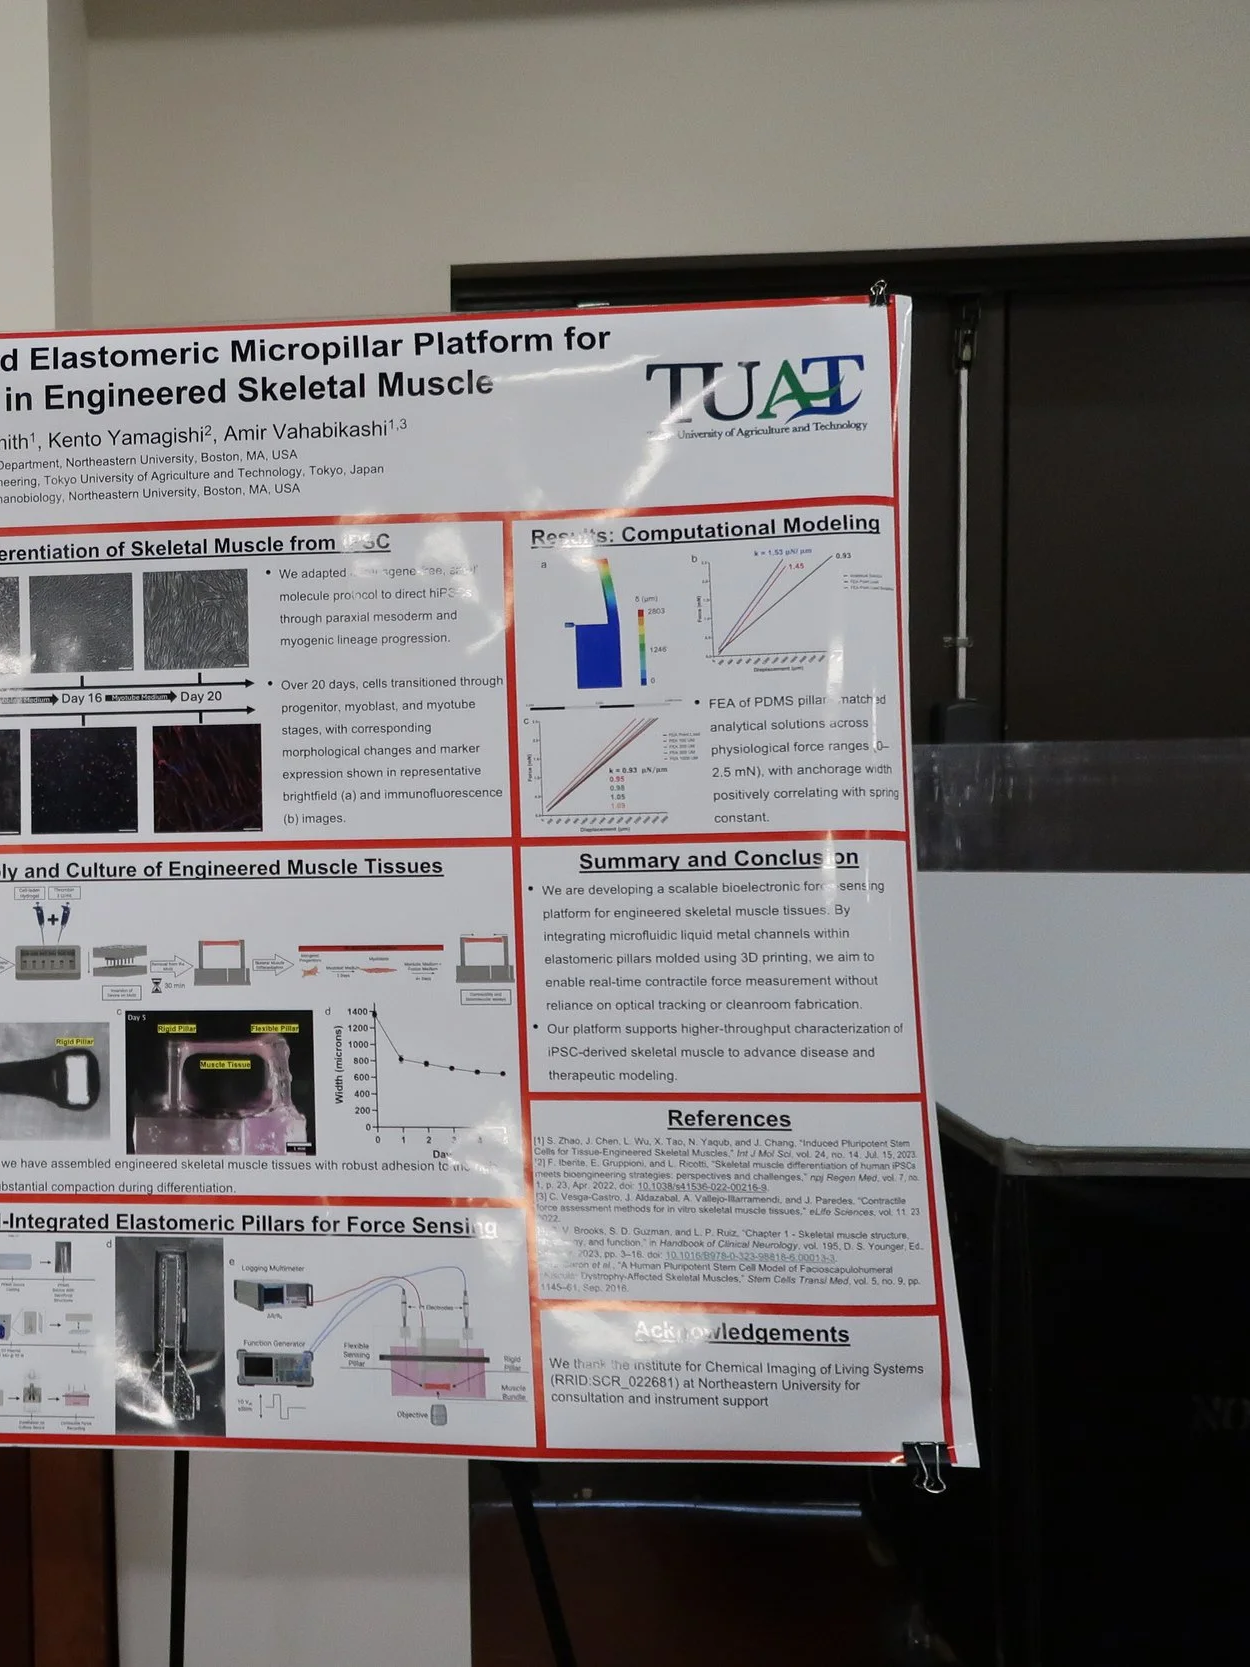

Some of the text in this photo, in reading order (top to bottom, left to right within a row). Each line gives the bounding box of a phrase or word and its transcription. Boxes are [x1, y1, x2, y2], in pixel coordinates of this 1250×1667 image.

[30, 341, 219, 370] Elastomeric
[231, 334, 403, 365] Micropillar
[414, 329, 552, 355] Platform
[563, 325, 610, 350] for
[5, 386, 32, 411] in
[44, 378, 225, 415] Engineered
[237, 372, 365, 402] Skeletal
[378, 369, 493, 397] Muscle
[646, 355, 864, 424] TUAT
[48, 431, 101, 448] Kento
[223, 424, 267, 441] Amir
[677, 428, 723, 440] University
[724, 427, 736, 437] of
[735, 422, 790, 438] Agriculture
[791, 422, 810, 432] and
[811, 419, 868, 431] Technology
[65, 455, 136, 470] Northeastern
[139, 452, 197, 465] University,
[200, 451, 242, 462] Boston,
[246, 448, 268, 461] MA,
[271, 448, 298, 460] USA
[43, 474, 77, 487] Tokyo
[80, 471, 134, 484] University
[134, 470, 149, 481] of
[150, 468, 210, 483] Agriculture
[211, 467, 234, 479] and
[237, 466, 305, 479] Technology,
[308, 464, 346, 477] Tokyo,
[349, 464, 384, 476] Japan
[68, 488, 140, 502] Northeastern
[142, 486, 199, 500] University,
[200, 483, 245, 496] Boston,
[248, 483, 270, 495] MA,
[274, 482, 300, 494] USA
[621, 525, 777, 543] Computational
[784, 515, 881, 534] Modeling
[105, 545, 127, 558] of
[130, 540, 208, 556] Skeletal
[213, 536, 283, 554] Muscle
[289, 536, 335, 550] from
[277, 631, 450, 648] myogenic lineage progression.
[62, 692, 102, 706] Day 16
[180, 690, 222, 704] Day 20
[27, 862, 59, 880] and
[66, 861, 136, 879] Culture
[143, 860, 163, 878] of
[169, 859, 280, 879] Engineered
[287, 858, 357, 876] Muscle
[364, 857, 442, 875] Tissues
[579, 849, 859, 871] Summary and Concluson
[158, 1025, 174, 1033] Rigid
[200, 1061, 250, 1069] Muscle Tissue
[335, 1026, 344, 1104] Width (microns)
[548, 1069, 677, 1083] therapeutic modeling.
[668, 1110, 791, 1128] References
[116, 1213, 234, 1232] Elastomeric
[241, 1214, 304, 1233] Pillars
[311, 1215, 340, 1234] for
[347, 1215, 405, 1235] Force
[413, 1217, 498, 1239] Sensing
[242, 1265, 267, 1273] Logging
[273, 1340, 305, 1348] Generator
[551, 1391, 769, 1409] consultation and instrument support
[397, 1411, 428, 1420] Objective
